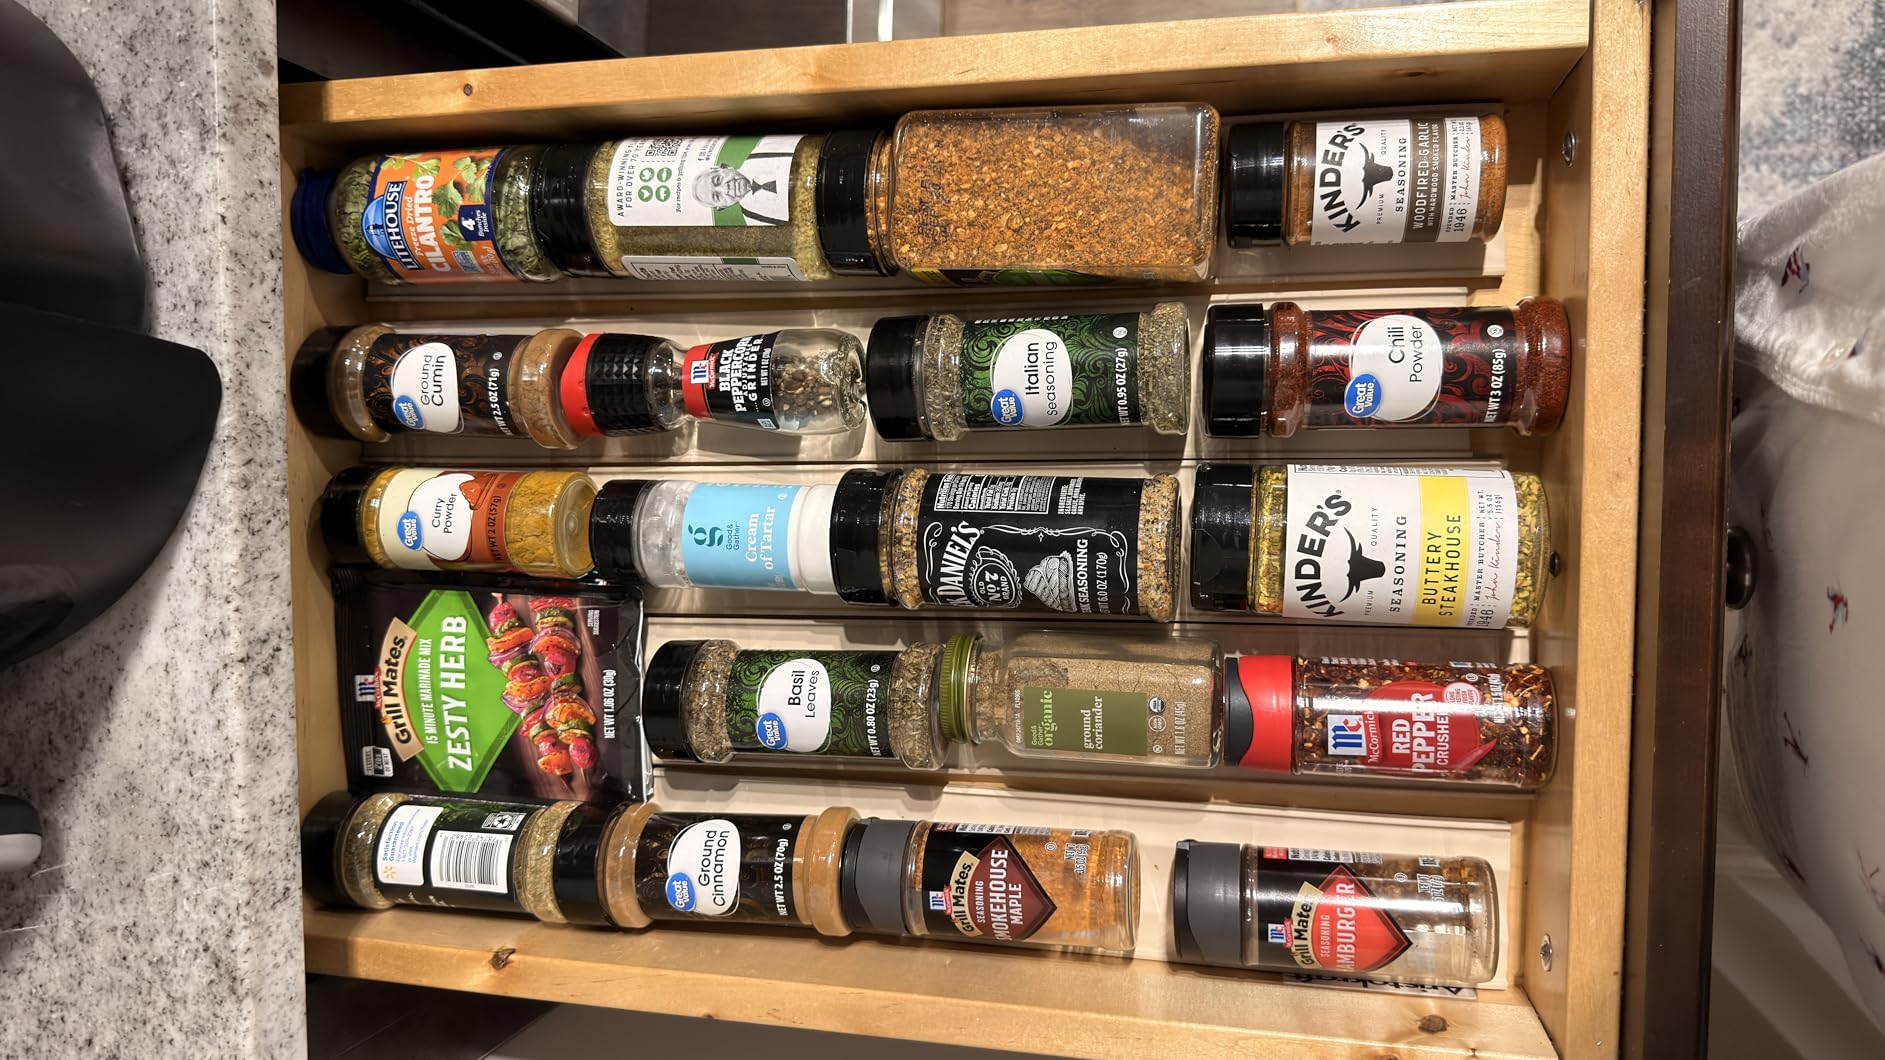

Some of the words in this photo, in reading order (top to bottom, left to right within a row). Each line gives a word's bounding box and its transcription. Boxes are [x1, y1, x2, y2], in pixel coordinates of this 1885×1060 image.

[1418, 122, 1429, 155] GARLIC
[617, 150, 631, 216] AWARD-WINNING
[626, 165, 635, 186] OVER
[631, 154, 638, 162] 70
[1319, 125, 1365, 232] KINDER'S
[1396, 138, 1406, 212] SEASONING
[1413, 161, 1428, 228] WOODFIRED
[1428, 173, 1438, 211] HARDWOOD
[1459, 174, 1471, 199] John
[405, 196, 414, 224] Dried
[1376, 194, 1384, 224] PREMIUM
[1446, 208, 1454, 232] FOUNDED
[1454, 208, 1467, 232] 1946
[386, 183, 418, 268] LITEHOUSE
[414, 175, 451, 272] CILANTRO
[462, 219, 475, 231] 4
[475, 210, 485, 236] Bunches
[408, 227, 424, 257] Freeze
[1387, 327, 1405, 363] Chili
[1409, 326, 1422, 382] Powder
[719, 349, 734, 391] BLACK
[742, 344, 752, 396] ADJUSTABLE
[1025, 343, 1040, 395] Italian
[1116, 348, 1128, 372] (27g)
[1492, 349, 1506, 374] (85g)
[420, 355, 432, 405] Ground
[431, 356, 446, 406] Cumin
[488, 369, 499, 390] (71g)
[1043, 342, 1058, 415] Seasoning
[1117, 373, 1126, 385] OZ
[1491, 376, 1502, 387] OZ
[489, 392, 498, 402] OZ
[1009, 397, 1017, 417] Value
[1118, 387, 1127, 405] 0.95
[1352, 383, 1367, 413] Great
[1364, 383, 1375, 407] Value
[1488, 398, 1500, 410] WT
[398, 402, 416, 426] Great
[409, 403, 418, 422] Value
[492, 404, 501, 415] 2.5
[495, 416, 506, 426] WT
[998, 397, 1010, 423] Great
[1119, 407, 1128, 416] WT
[1485, 411, 1497, 422] NET
[488, 496, 501, 515] (57g)
[968, 484, 980, 509] Calories
[432, 498, 445, 527] Curry
[444, 493, 457, 533] Powder
[487, 517, 495, 527] OZ
[403, 519, 413, 546] Great
[488, 536, 497, 547] WT
[746, 513, 760, 562] Cream
[760, 506, 776, 552] Tartar
[760, 554, 774, 570] of
[937, 521, 981, 596] DANIEL'S
[1096, 553, 1108, 578] (170g)
[1294, 494, 1352, 617] KINDER'S
[1389, 516, 1406, 612] SEASONING
[1421, 532, 1441, 605] BUTTERY
[1438, 515, 1461, 616] STEAKHOUSE
[984, 571, 999, 582] 7
[1077, 539, 1090, 602] SEASONING
[1000, 576, 1010, 599] BRAND
[1096, 580, 1107, 589] OZ
[1097, 591, 1108, 601] 6.0
[1474, 568, 1483, 601] MASTER
[1485, 573, 1500, 600] John
[1364, 590, 1374, 616] PREMIUM
[1477, 609, 1494, 626] 1946
[419, 639, 432, 655] MIX
[440, 616, 467, 688] HERB
[383, 636, 406, 697] Mates
[418, 657, 432, 701] MARINADE
[603, 669, 616, 686] (30g)
[603, 688, 614, 697] OZ
[787, 670, 805, 706] Basil
[805, 671, 819, 718] Leaves
[866, 679, 879, 701] (23g)
[603, 698, 615, 712] 1.06
[866, 703, 875, 714] OZ
[1174, 701, 1186, 715] (45g)
[385, 703, 412, 744] Grill
[422, 704, 437, 733] MINUTE
[604, 714, 615, 726] WT
[867, 716, 876, 734] 0.80
[1040, 691, 1058, 746] organic
[1080, 709, 1094, 749] ground
[1092, 696, 1103, 749] coriander
[1175, 726, 1185, 734] 1.6
[425, 736, 439, 744] 15
[441, 694, 472, 771] ZESTY
[604, 727, 615, 738] NET
[763, 720, 776, 746] Great
[868, 735, 878, 745] WT
[1175, 736, 1185, 744] WT
[1392, 719, 1410, 753] RED
[1175, 745, 1185, 754] NET
[383, 821, 397, 861] Satisfaction
[389, 822, 404, 861] Guaranteed
[775, 839, 788, 861] (70g)
[698, 830, 717, 886] Ground
[712, 830, 730, 906] Cinnamon
[774, 862, 783, 873] OZ
[672, 880, 684, 908] Great
[681, 881, 690, 902] Value
[774, 876, 783, 889] 2.5
[953, 863, 971, 907] Mates
[989, 849, 1012, 940] SMOKEHOUSE
[775, 890, 784, 903] WT
[777, 904, 788, 915] NET
[976, 881, 985, 923] SEASONING
[1009, 883, 1023, 924] MAPLE
[956, 911, 974, 932] Grill
[1320, 915, 1330, 957] SEASONING
[1295, 944, 1314, 964] Grill
